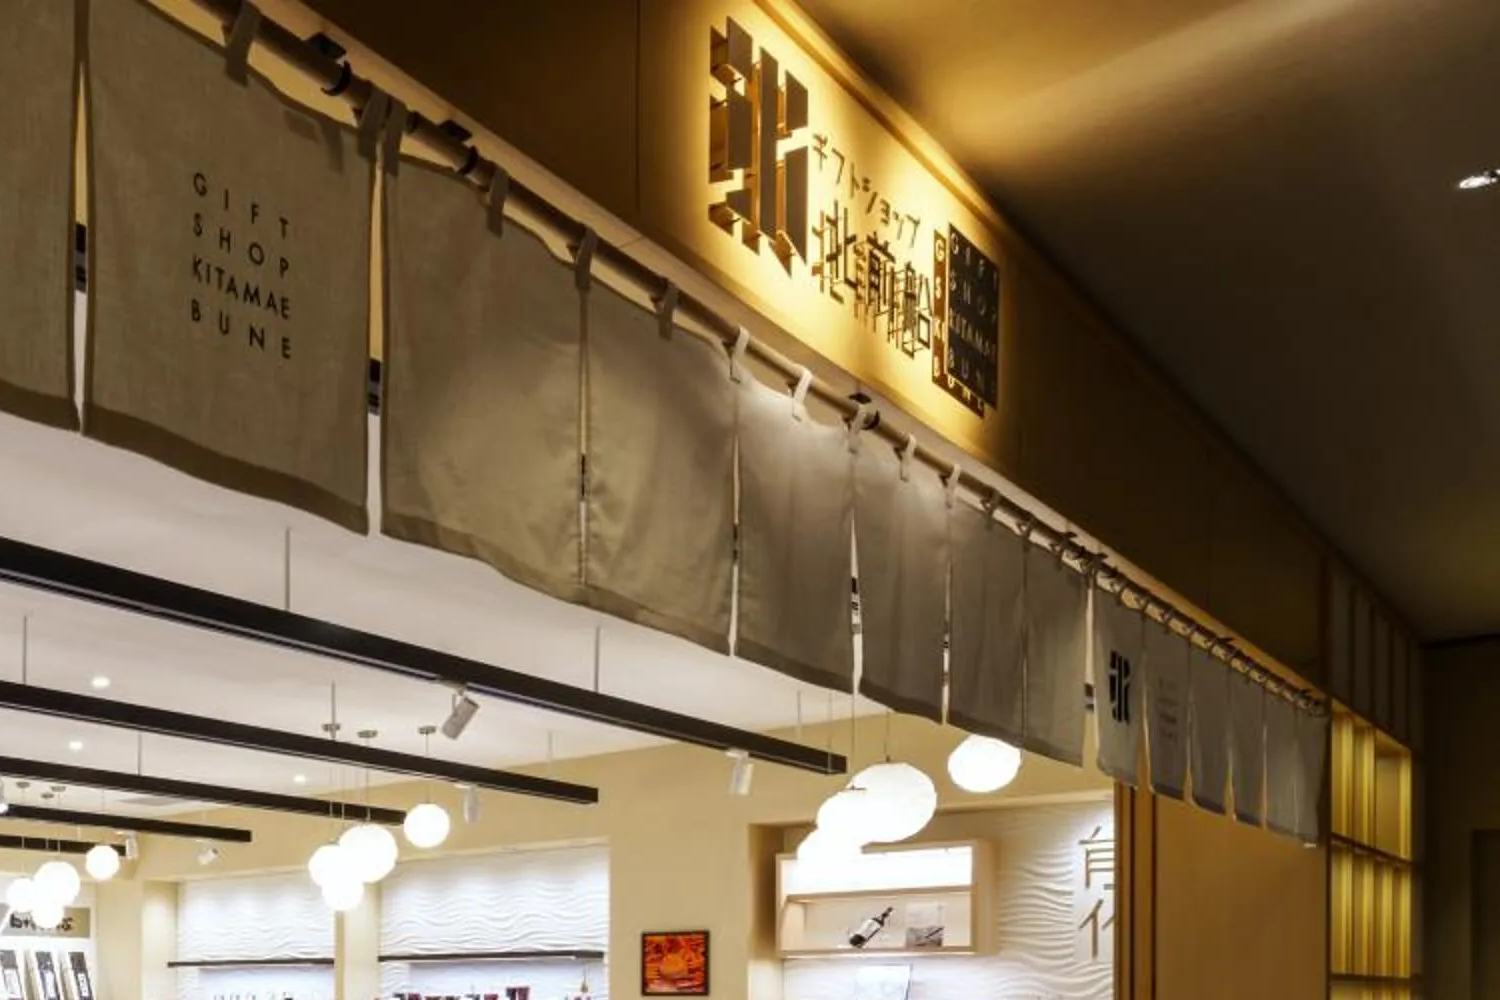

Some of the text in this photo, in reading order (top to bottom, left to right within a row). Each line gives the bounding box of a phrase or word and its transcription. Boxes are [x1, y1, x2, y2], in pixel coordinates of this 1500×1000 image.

[193, 172, 289, 239] GIFT
[193, 212, 289, 279] SHOP
[192, 253, 291, 321] KITAMAE
[191, 298, 291, 360] BUNE
